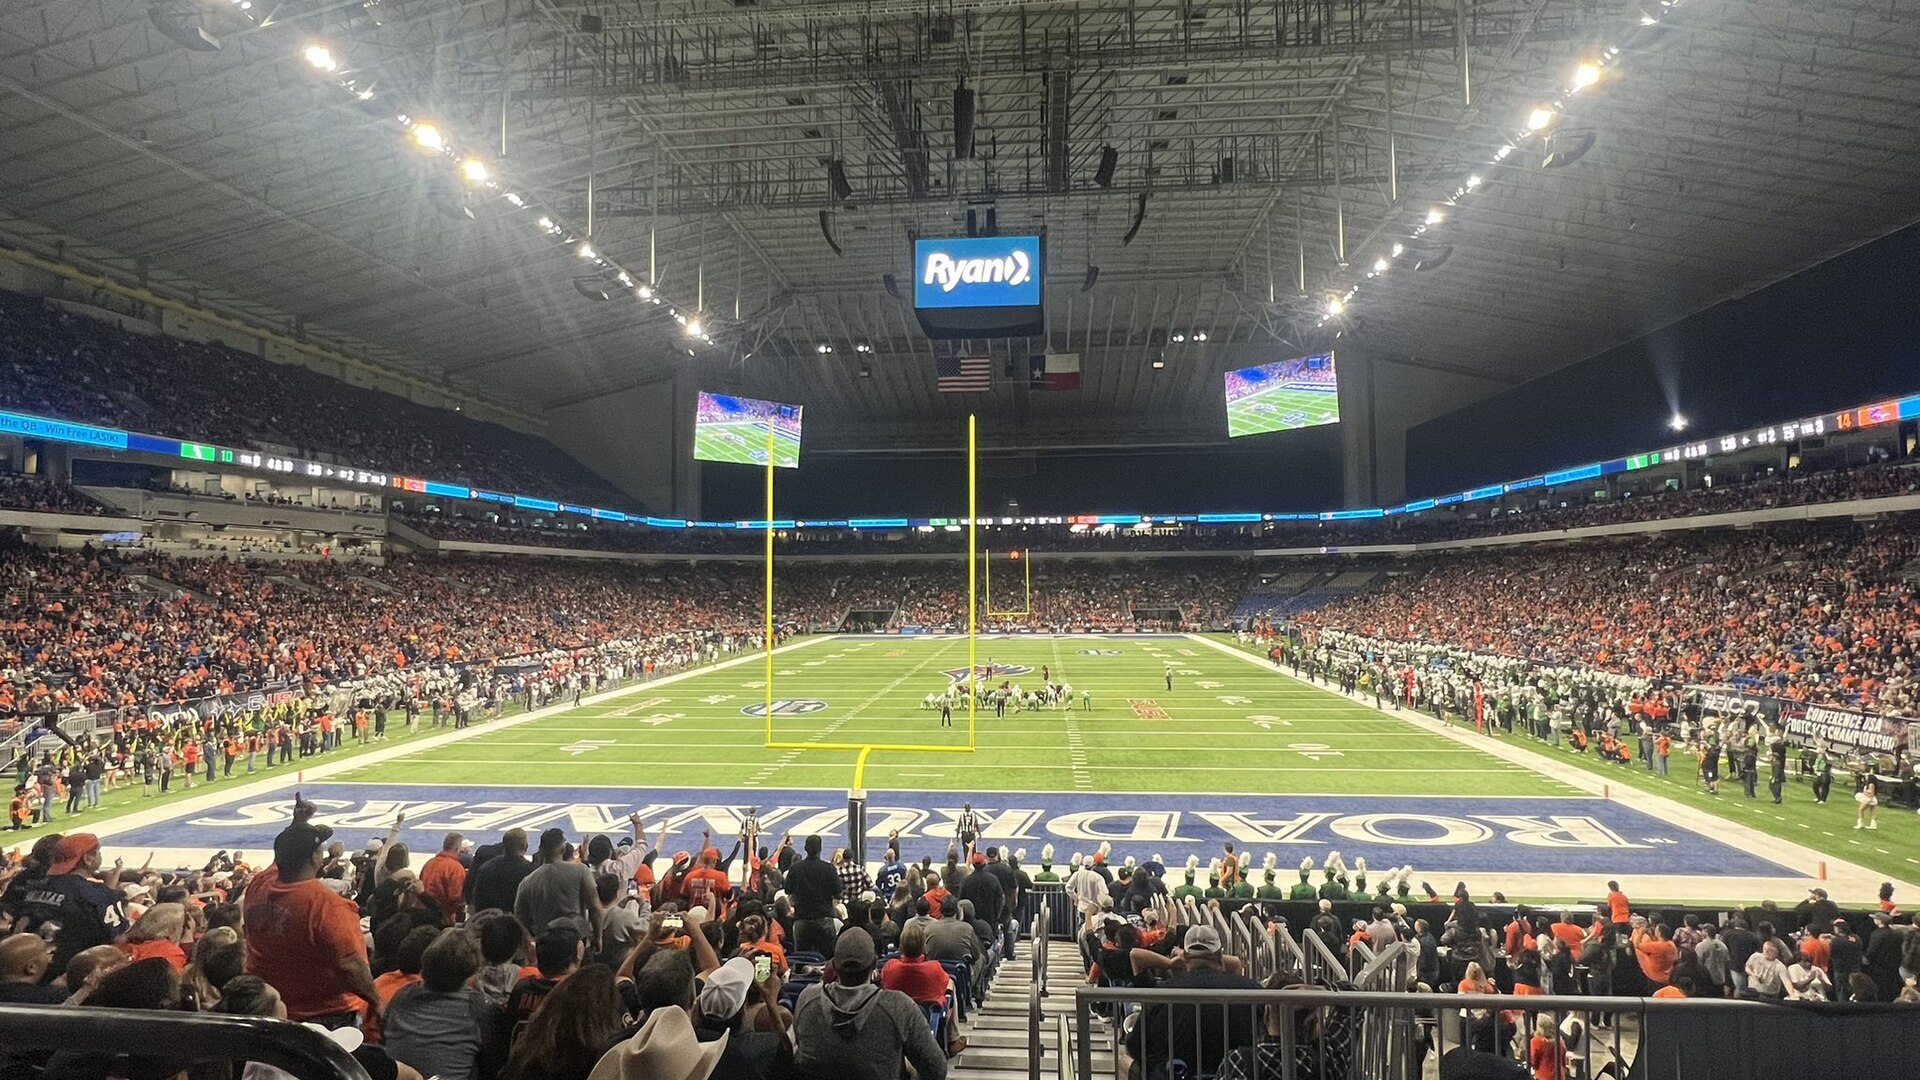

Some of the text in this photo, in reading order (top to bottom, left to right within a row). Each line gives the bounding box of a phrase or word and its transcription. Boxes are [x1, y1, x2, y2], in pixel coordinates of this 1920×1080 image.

[924, 252, 1001, 292] Ryan
[1, 418, 19, 429] the
[21, 420, 37, 432] QB
[46, 424, 64, 435] Win
[66, 428, 88, 439] Free
[89, 431, 119, 443] LASIK!
[1836, 413, 1852, 430] 14
[221, 449, 234, 463] 10
[1804, 706, 1865, 729] CONFERENCE
[1862, 716, 1883, 733] USA
[185, 799, 1656, 848] ROADRUNNERS
